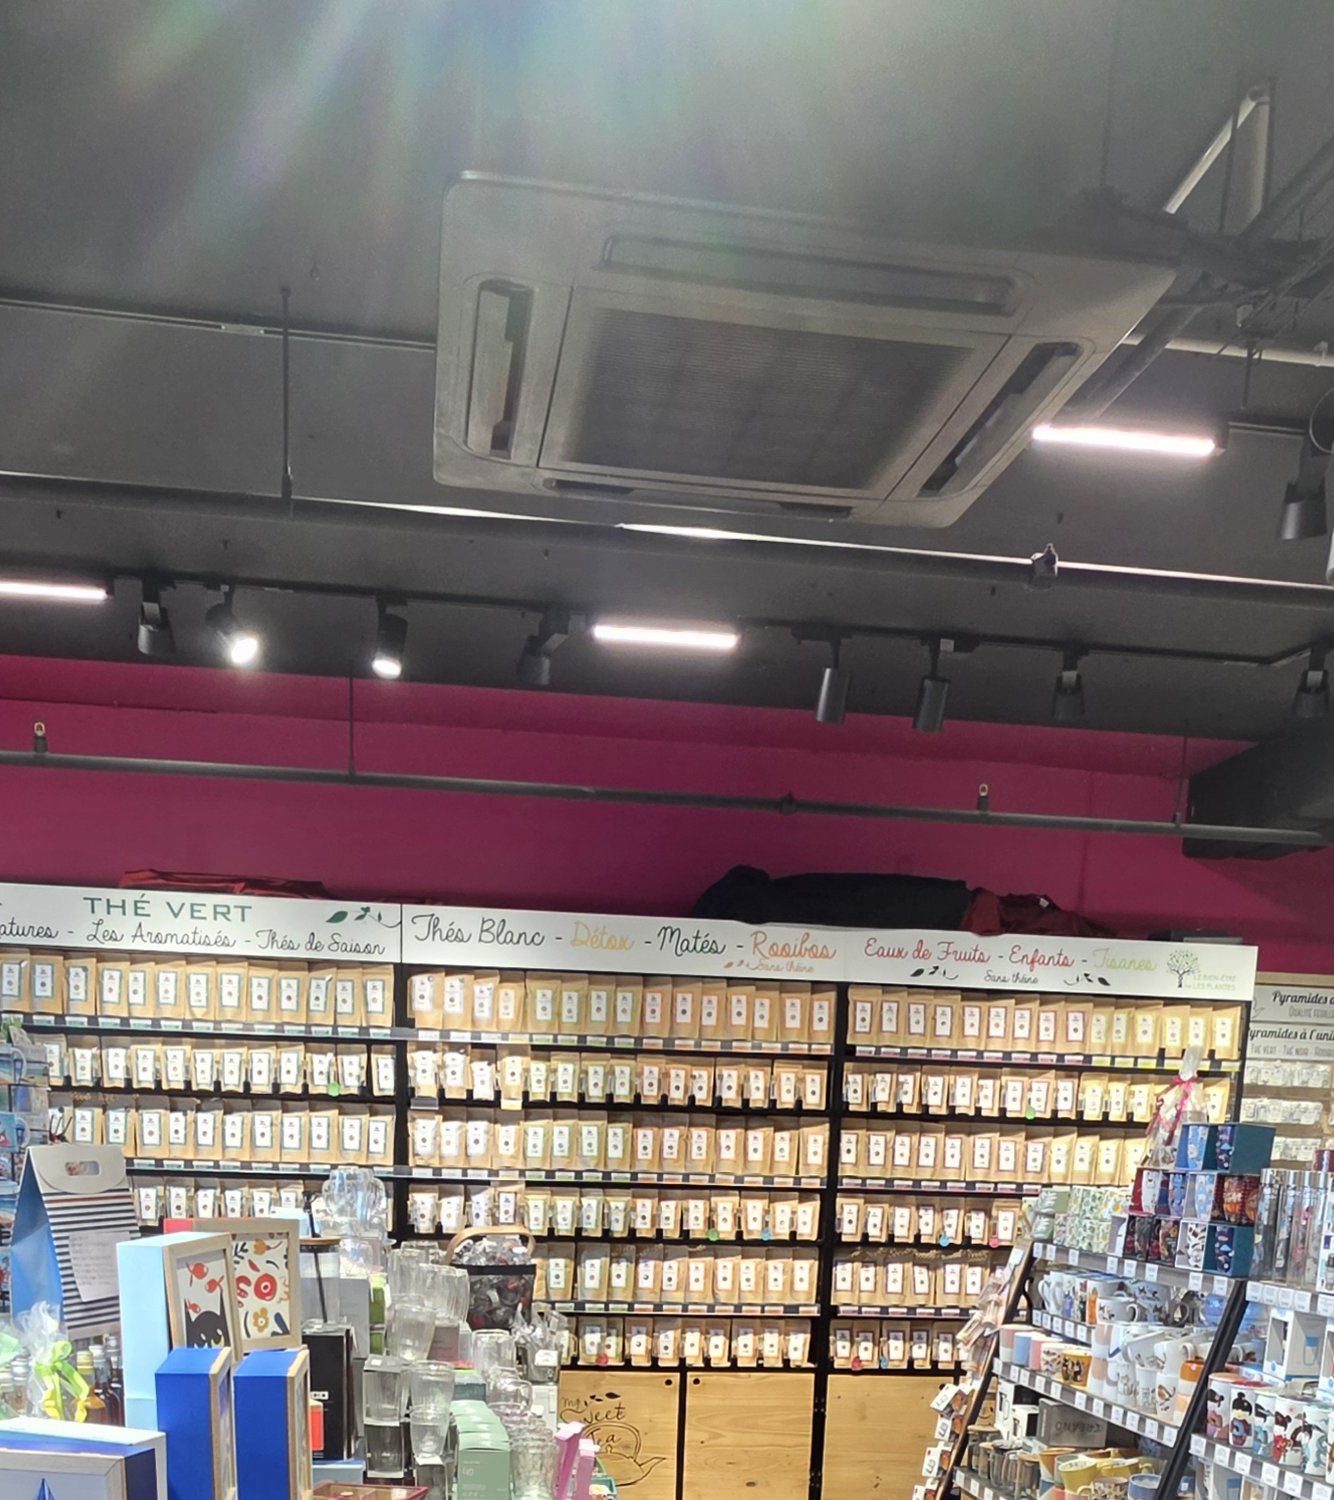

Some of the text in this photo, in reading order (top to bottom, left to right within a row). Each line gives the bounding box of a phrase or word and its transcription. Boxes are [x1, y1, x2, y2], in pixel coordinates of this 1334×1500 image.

[83, 894, 252, 922] THÉ VERT
[86, 919, 124, 944] Les
[131, 922, 236, 948] Aromatisés
[256, 929, 300, 951] Thés
[305, 932, 325, 951] de
[327, 932, 385, 955] Saison
[411, 913, 837, 959] Thés Blanc Détox Matés Rooibos
[864, 938, 1158, 972] Eaux de Fruits Enfants Tisanes
[984, 969, 1009, 983] Sans
[1272, 990, 1328, 1006] Pyramides
[1248, 1027, 1298, 1041] yramides
